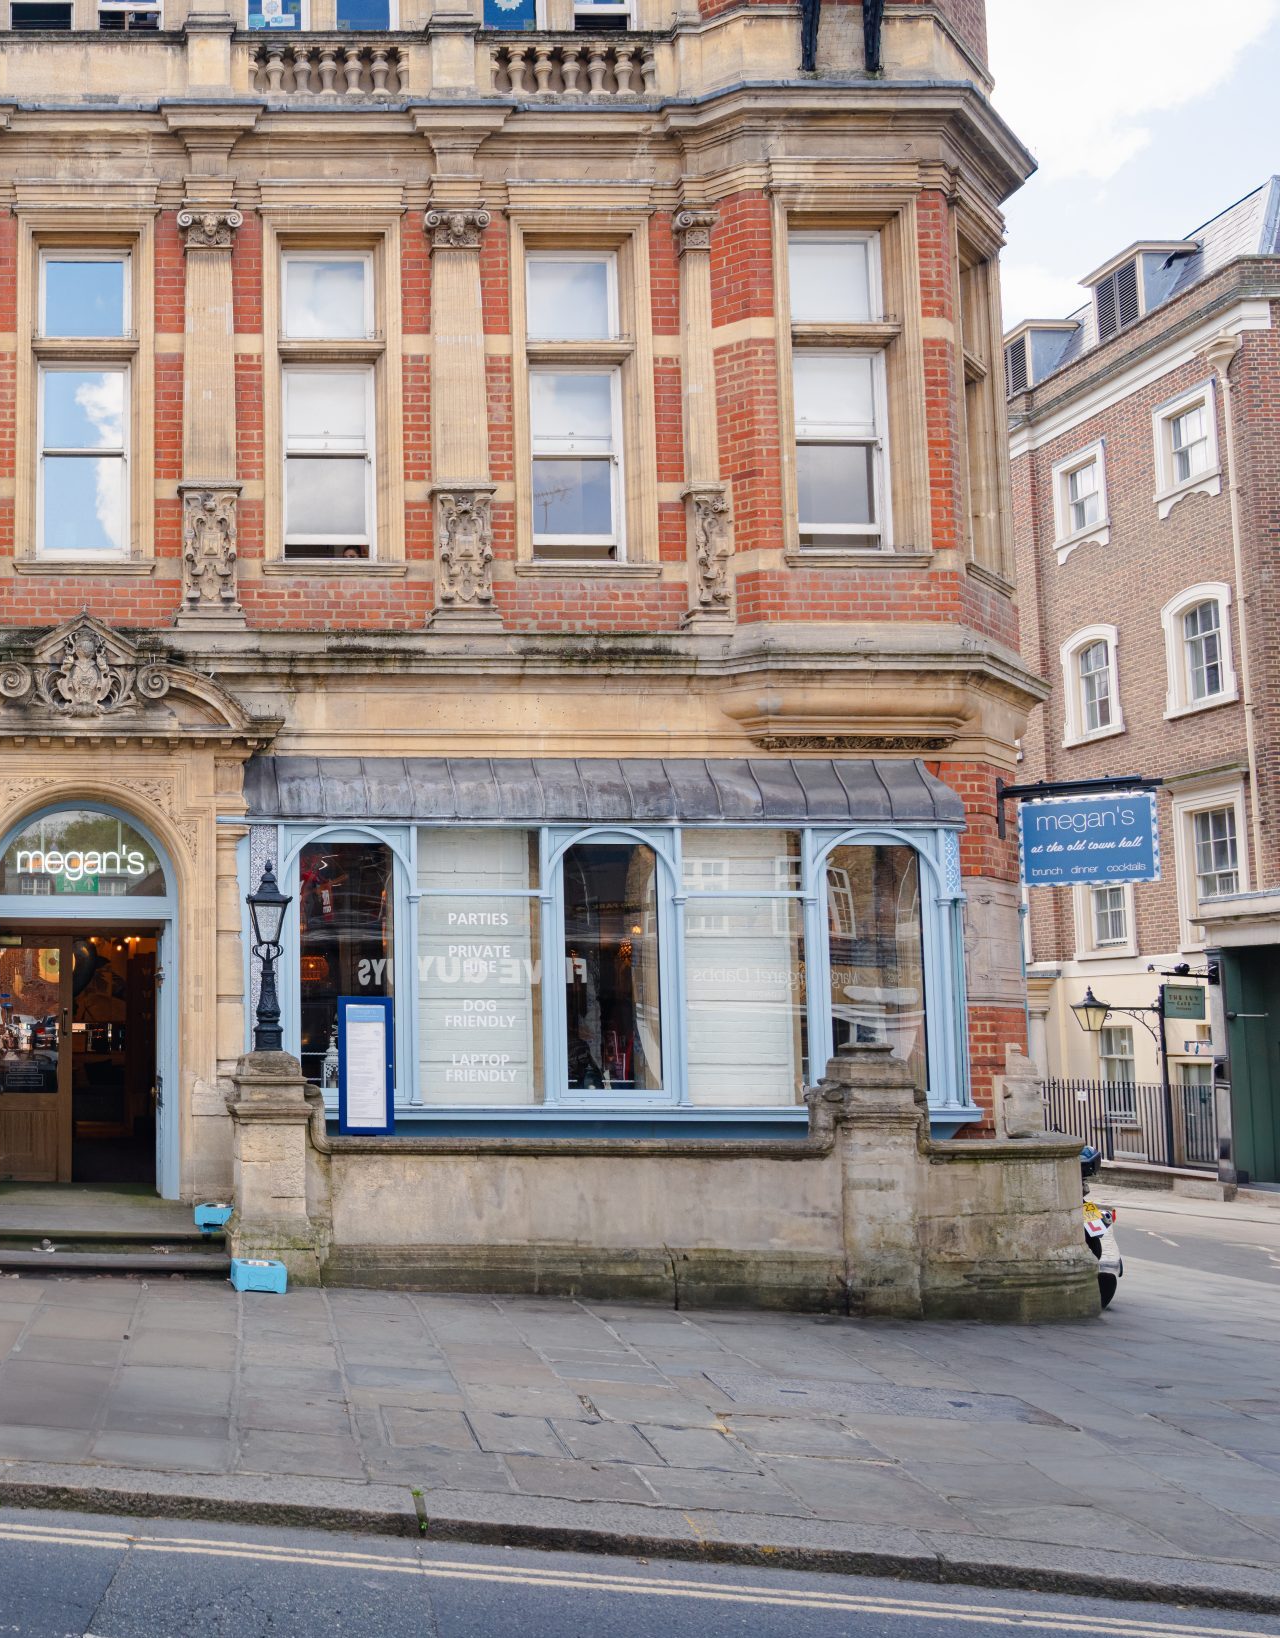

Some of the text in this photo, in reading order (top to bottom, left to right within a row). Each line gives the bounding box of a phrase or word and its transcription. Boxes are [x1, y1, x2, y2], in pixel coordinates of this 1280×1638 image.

[1036, 806, 1135, 833] megan's
[1031, 836, 1143, 854] at the old town hall
[16, 844, 145, 881] megan's
[1031, 862, 1146, 876] brunch dinner cocktails
[448, 913, 509, 926] PARTIES
[448, 945, 511, 958] PRIVATE
[463, 960, 497, 973] HIRE
[463, 1000, 497, 1012] DOG
[445, 1015, 516, 1028] FRIENDLY
[452, 1054, 510, 1066] LAPTOP
[446, 1069, 517, 1082] FRIENDLY
[1087, 1221, 1102, 1232] L
